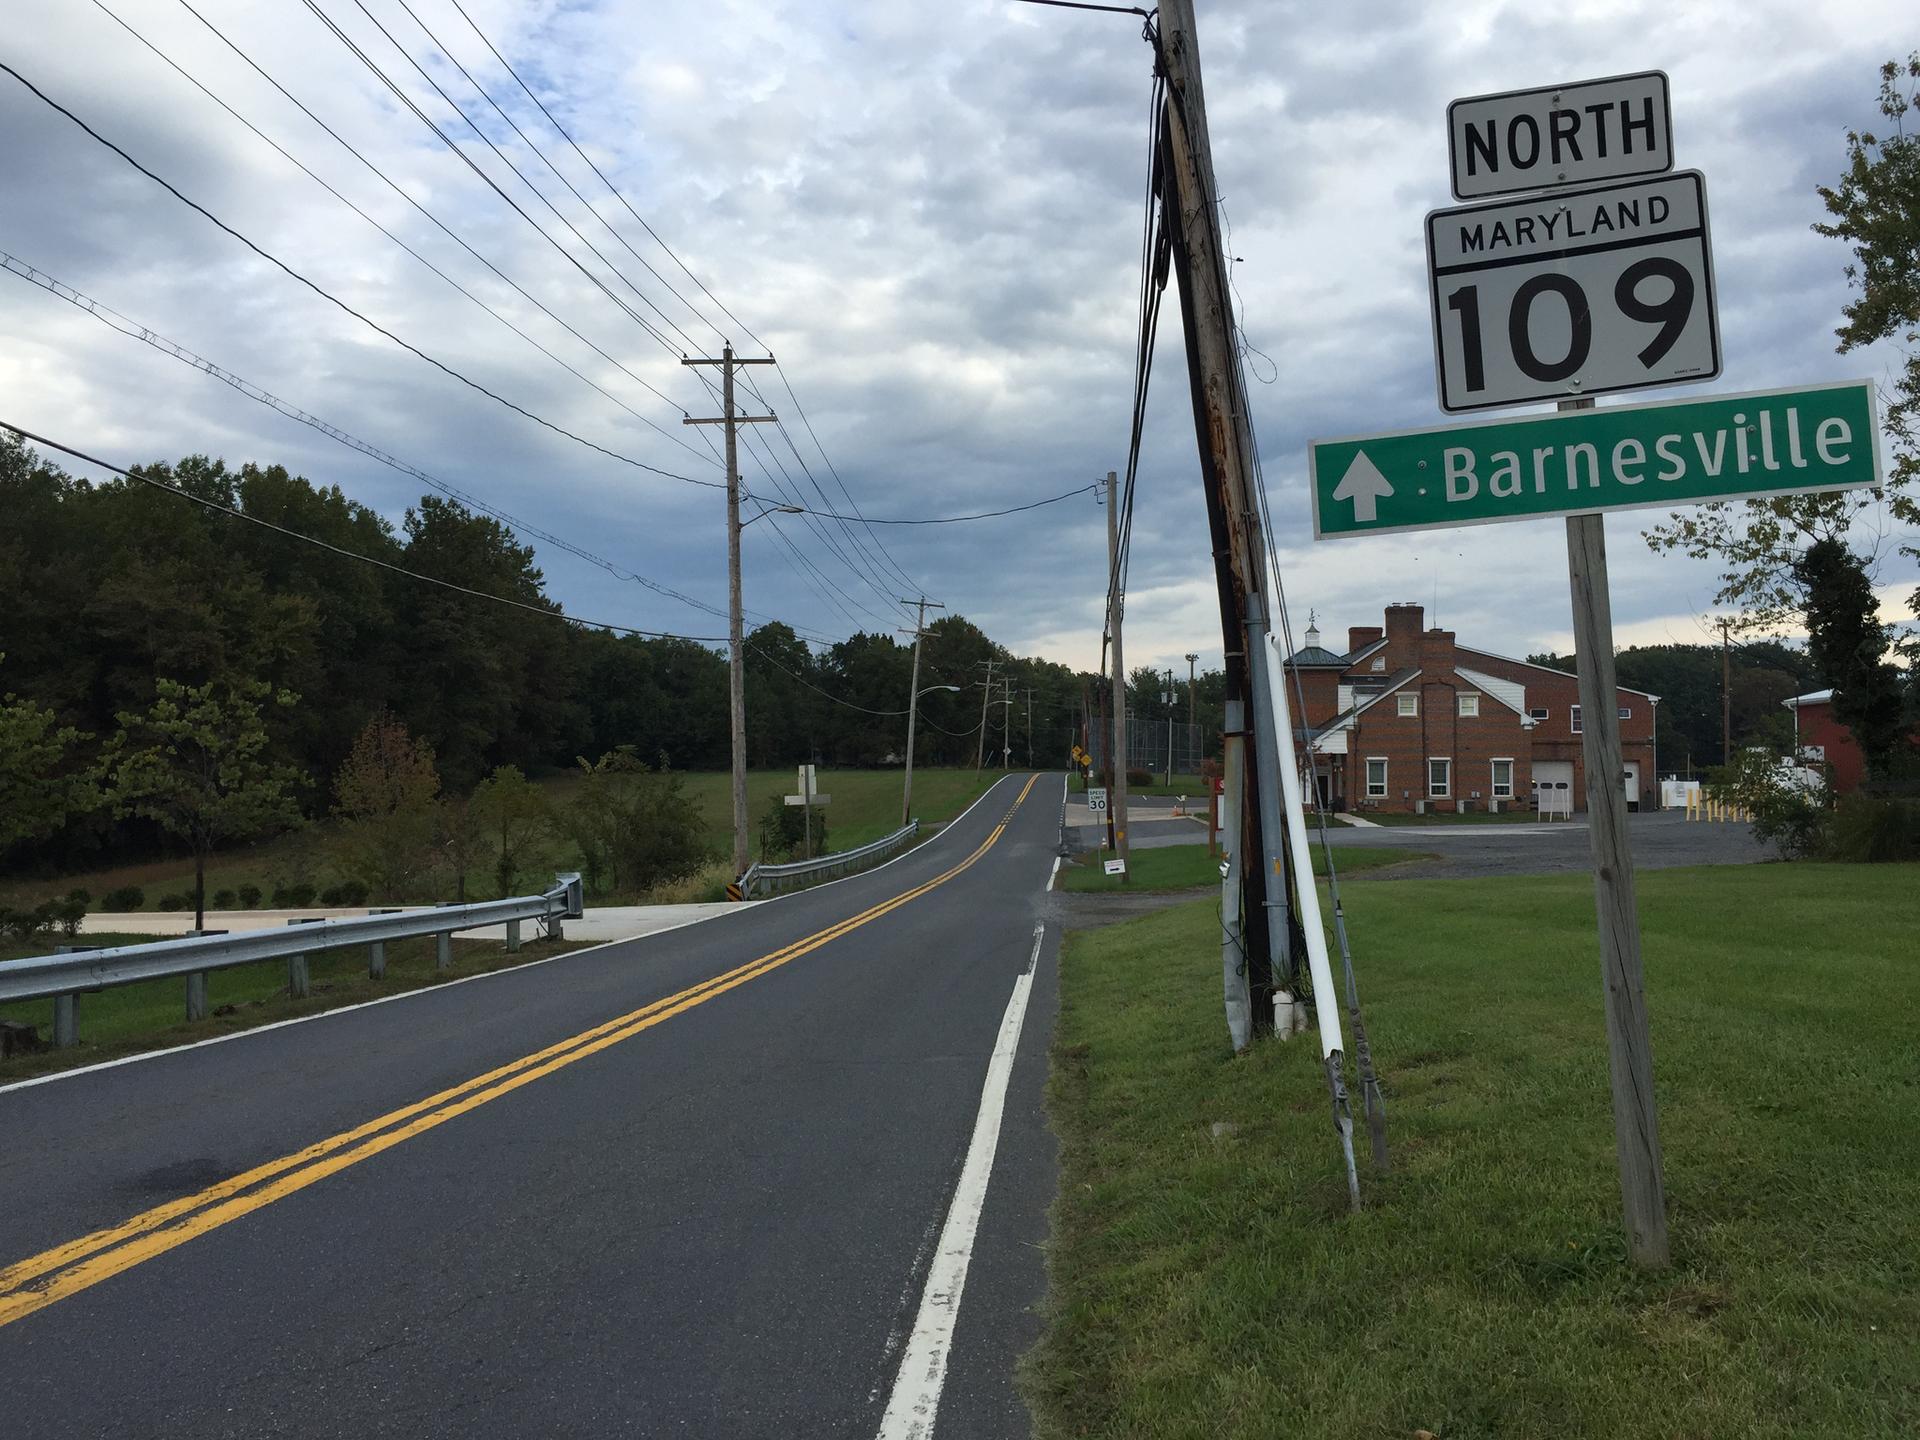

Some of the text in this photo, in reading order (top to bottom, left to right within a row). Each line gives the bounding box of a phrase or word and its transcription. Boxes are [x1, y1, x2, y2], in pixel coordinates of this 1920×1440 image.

[1464, 96, 1656, 176] NORTH
[1460, 195, 1670, 253] MARYLAND
[1448, 257, 1695, 393] 109
[1443, 407, 1853, 503] Barnesville
[1090, 800, 1105, 810] 30
